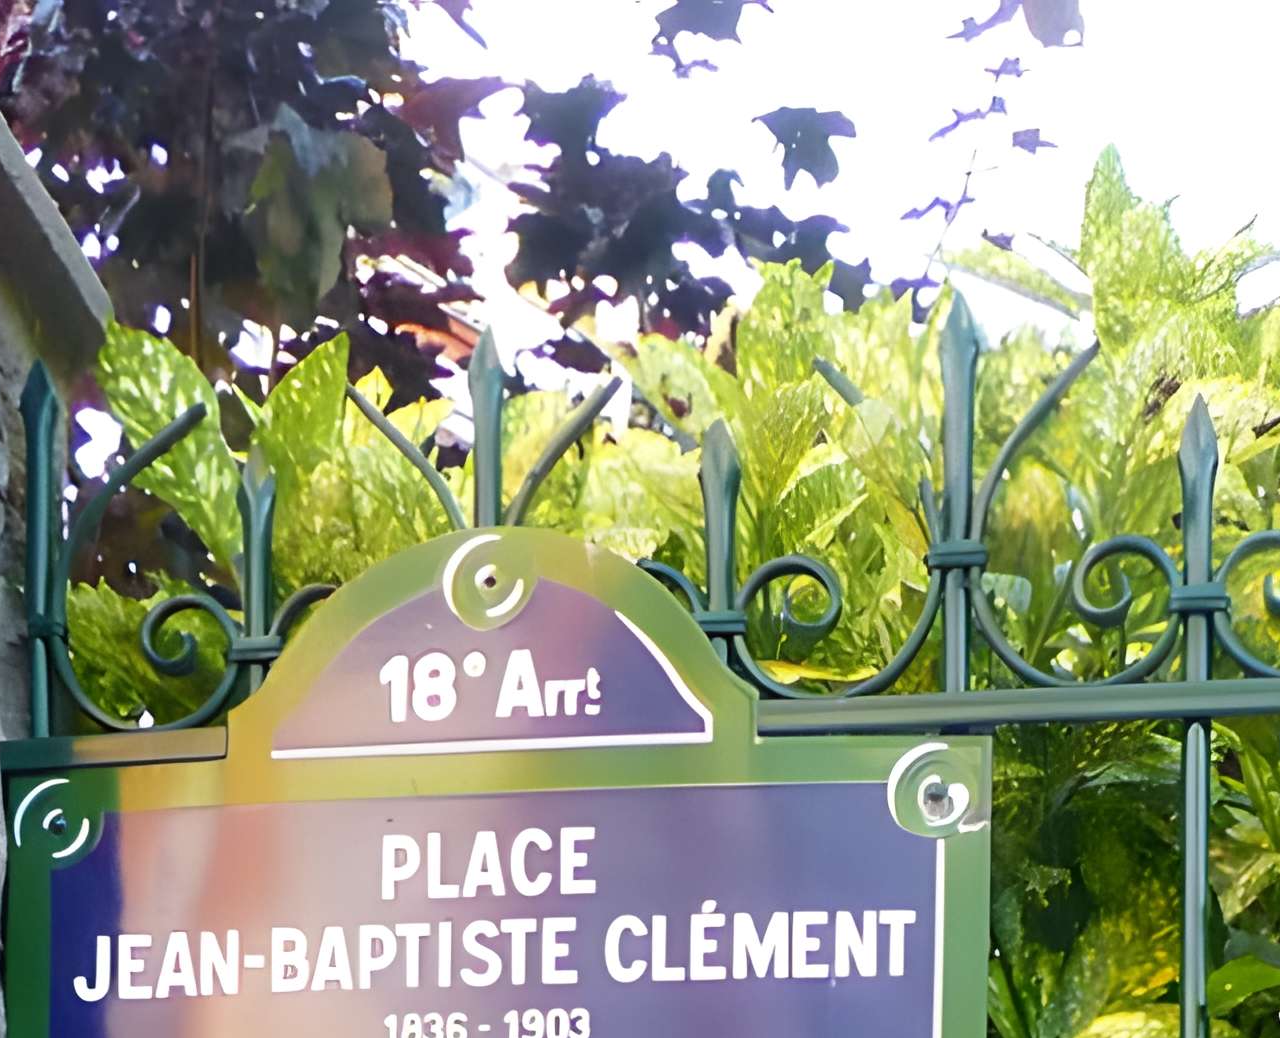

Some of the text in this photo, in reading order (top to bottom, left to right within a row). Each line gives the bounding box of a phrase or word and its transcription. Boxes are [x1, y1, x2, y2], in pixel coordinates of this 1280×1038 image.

[381, 826, 596, 901] PLACE
[73, 899, 916, 1002] JEAN-BAPTISTE CLÉMENT
